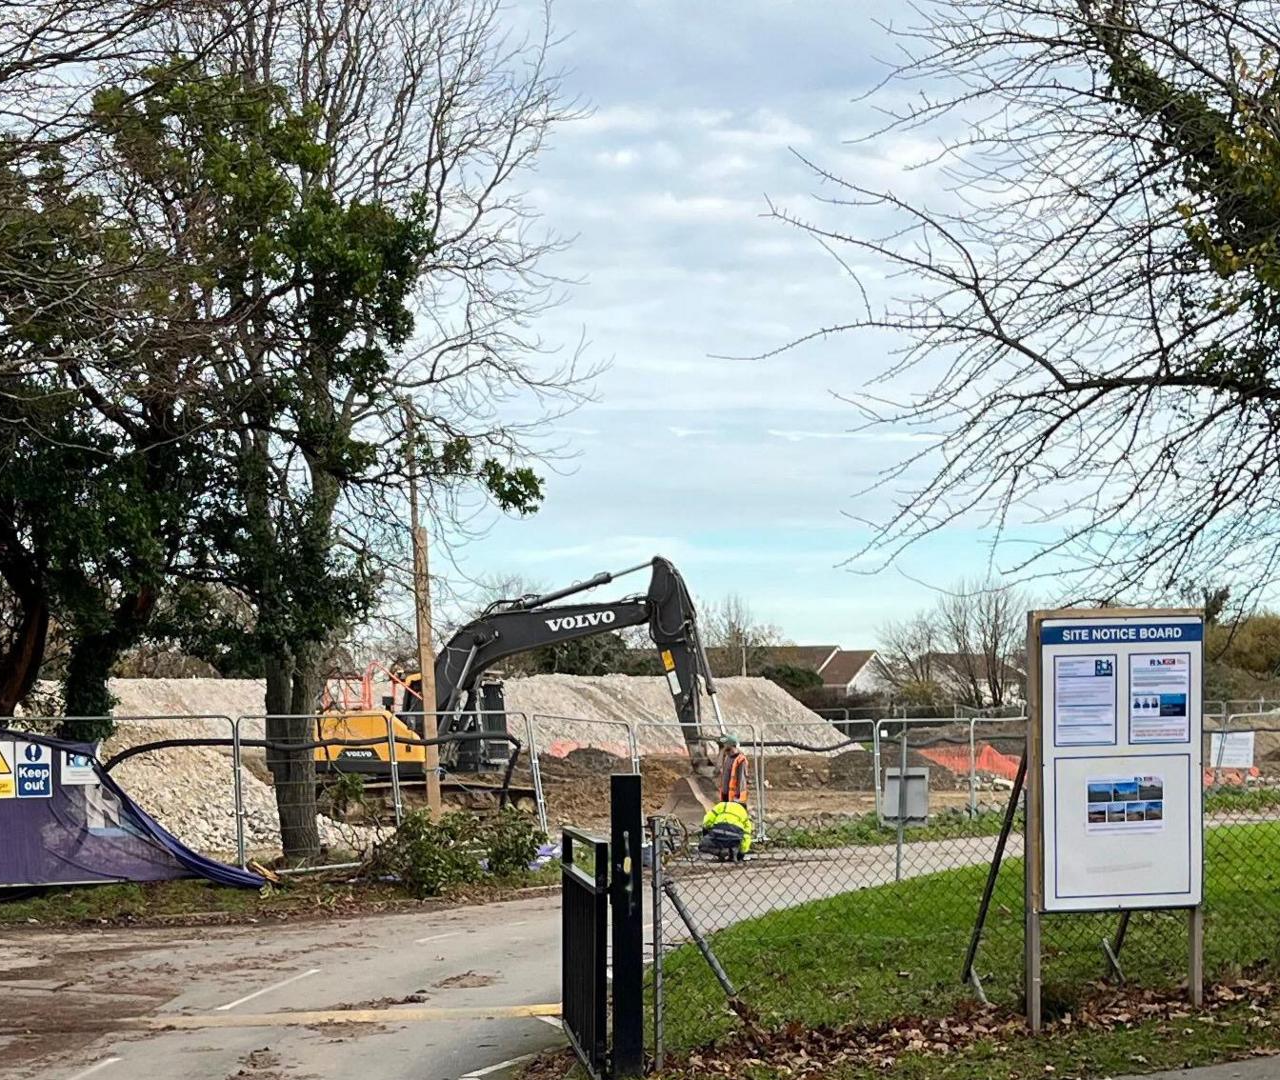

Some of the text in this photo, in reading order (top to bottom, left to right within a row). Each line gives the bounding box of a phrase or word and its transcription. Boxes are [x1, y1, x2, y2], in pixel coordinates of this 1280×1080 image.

[545, 611, 615, 632] VOLVO
[1062, 627, 1181, 640] SITE NOTICE BOARD
[19, 768, 49, 780] Keep
[24, 782, 45, 791] out
